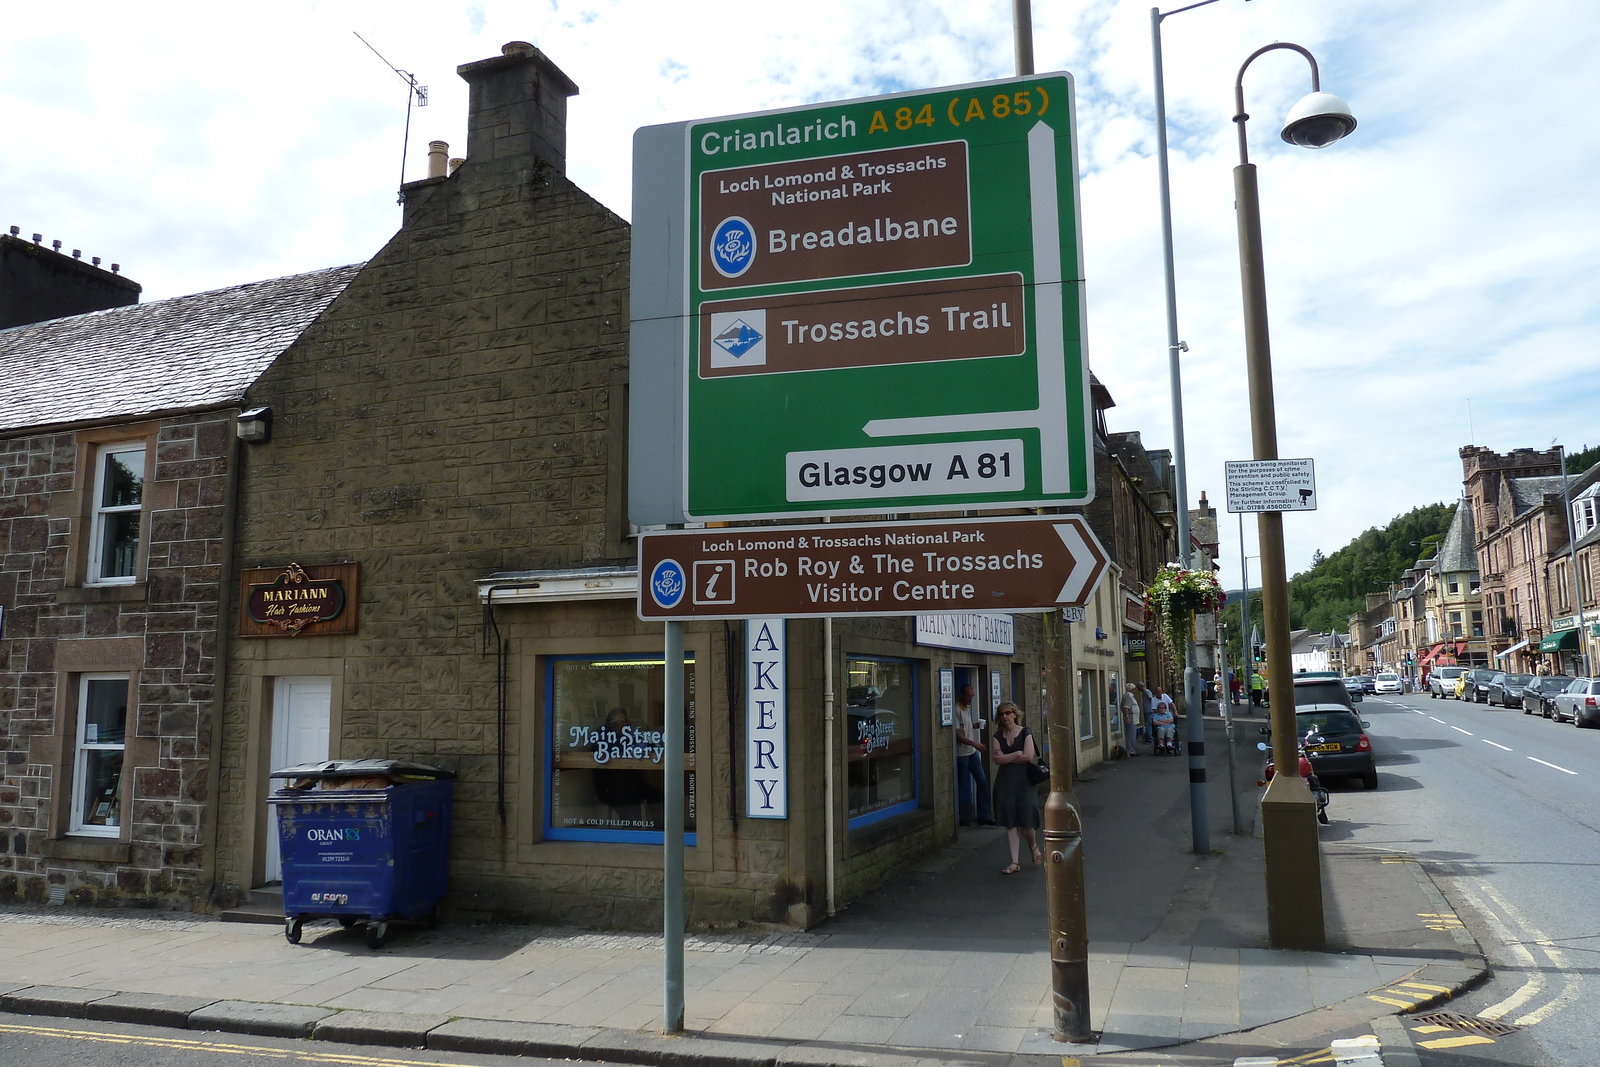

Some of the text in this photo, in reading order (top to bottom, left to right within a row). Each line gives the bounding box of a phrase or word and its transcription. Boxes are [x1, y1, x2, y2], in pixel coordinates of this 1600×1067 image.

[700, 115, 857, 156] Crianlarich
[719, 154, 947, 194] Loch Lomond & Trossachs
[771, 179, 892, 206] National Park
[768, 215, 958, 254] Breadalbane
[781, 302, 1011, 344] Trossachs Trail
[799, 460, 932, 489] Glasgow
[702, 530, 985, 553] Loch Lomond & Trossachs National Park
[743, 549, 1044, 580] Rob Roy & The Trossachs
[263, 588, 328, 602] MARIANN
[806, 578, 975, 604] Visitor Centre
[265, 603, 321, 616] Hair Fashions
[1062, 606, 1084, 621] ERY
[919, 614, 948, 636] MAIN
[950, 614, 982, 641] STREET
[569, 725, 617, 748] Main
[593, 740, 664, 764] Bakery
[307, 828, 343, 841] ORAN
